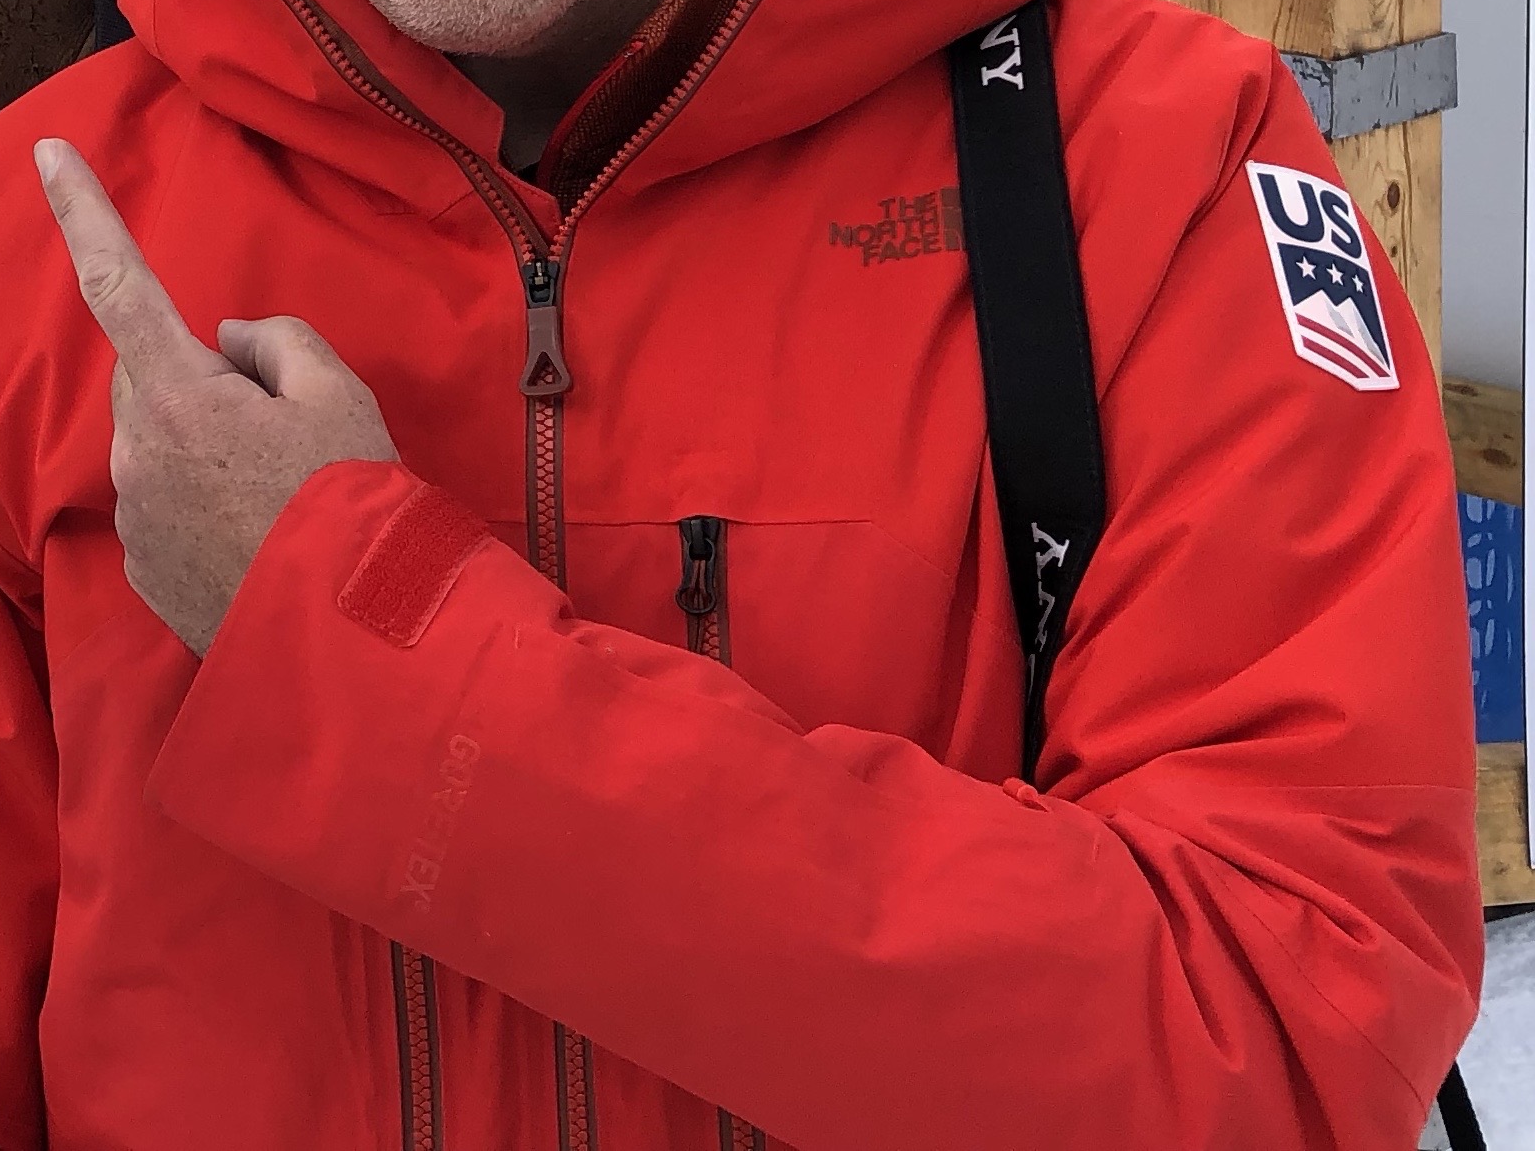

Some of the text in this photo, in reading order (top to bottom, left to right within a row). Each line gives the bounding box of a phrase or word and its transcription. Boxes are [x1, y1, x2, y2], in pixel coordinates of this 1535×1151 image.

[877, 191, 937, 219] THE
[1257, 172, 1363, 259] US
[829, 205, 940, 247] NORTH
[862, 234, 942, 267] FACE
